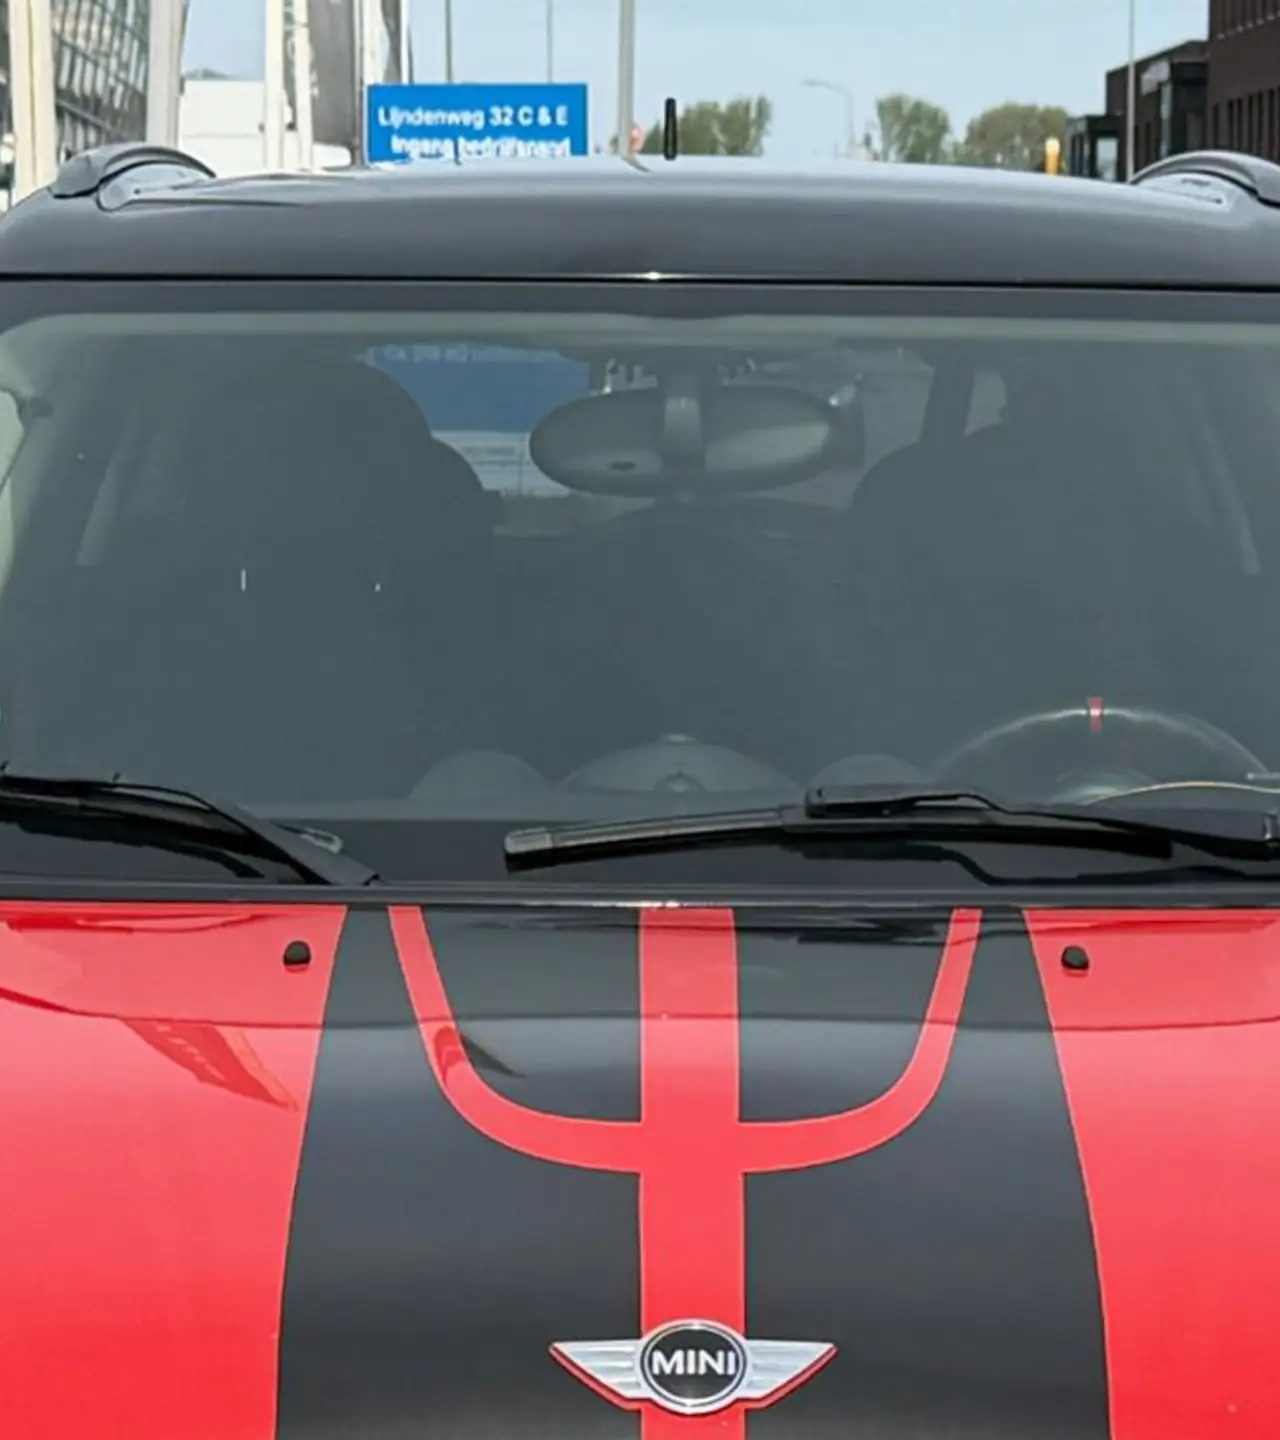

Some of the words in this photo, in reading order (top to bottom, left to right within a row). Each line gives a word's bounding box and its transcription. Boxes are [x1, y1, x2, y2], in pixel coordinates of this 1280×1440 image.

[489, 105, 514, 126] 32
[517, 105, 534, 126] C
[537, 105, 552, 126] &
[651, 1349, 736, 1376] MINI
